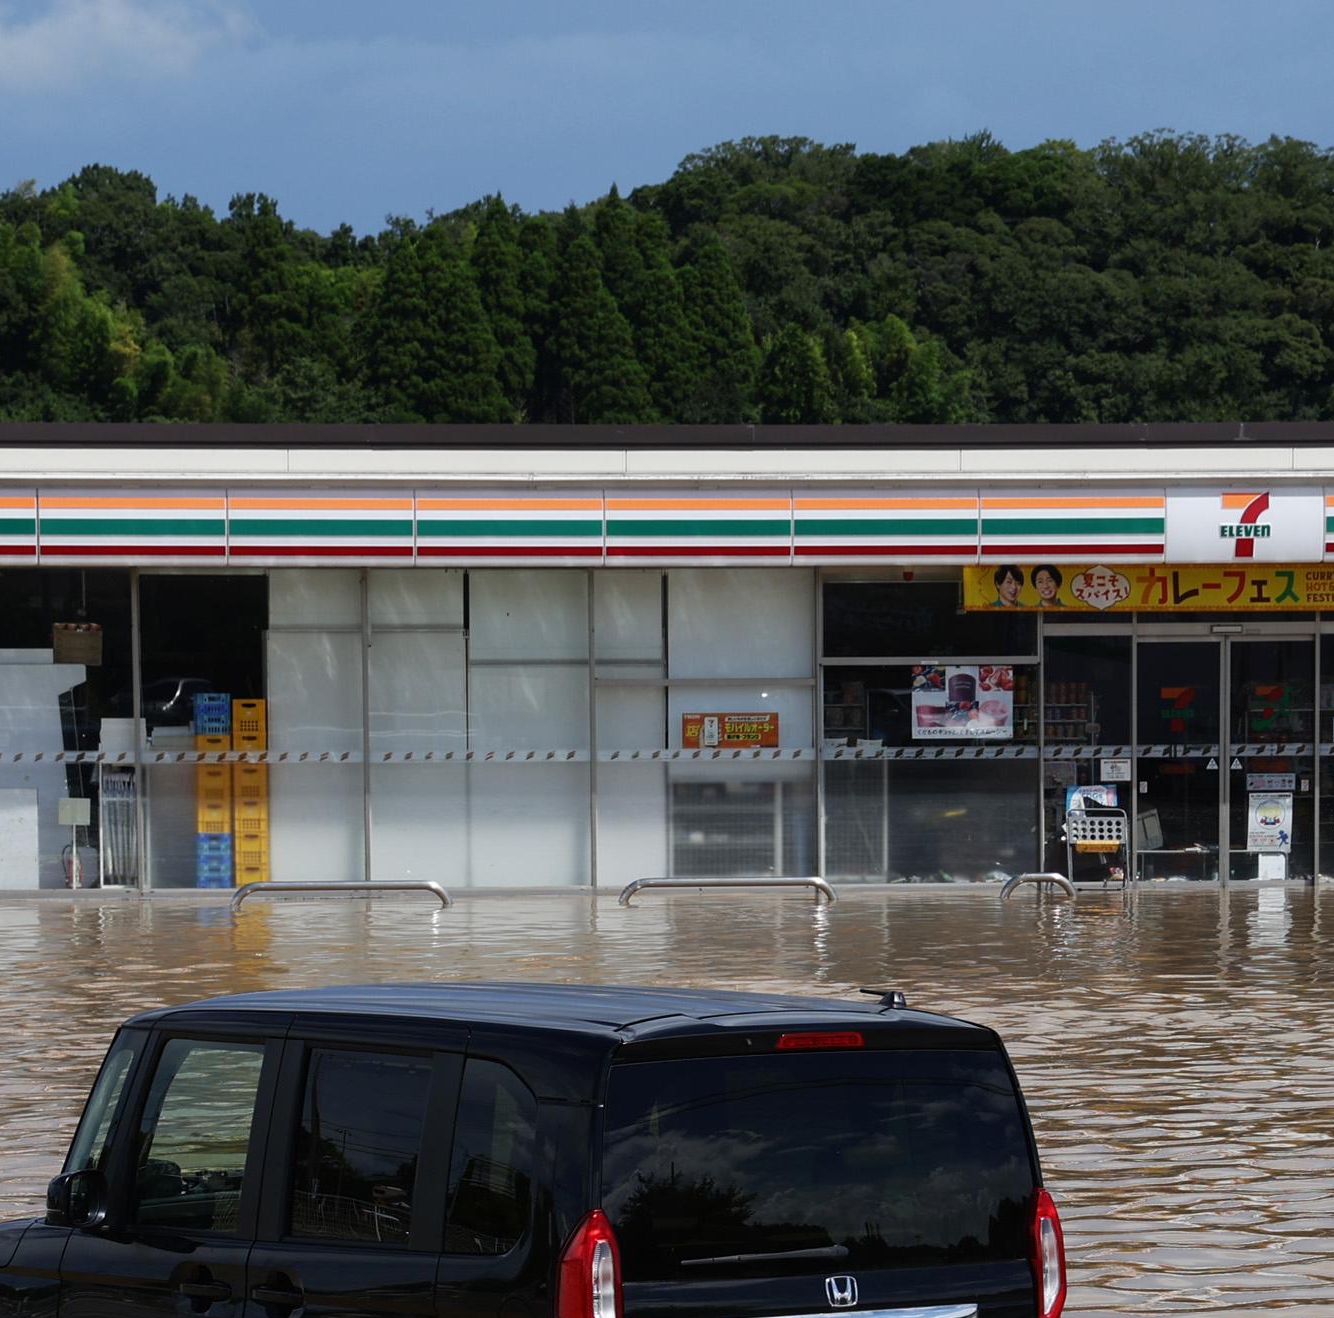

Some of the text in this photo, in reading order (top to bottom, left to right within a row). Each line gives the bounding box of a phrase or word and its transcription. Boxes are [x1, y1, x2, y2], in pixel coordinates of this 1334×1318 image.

[1083, 574, 1119, 587] 夏こそ
[1136, 567, 1299, 604] カレーフェス
